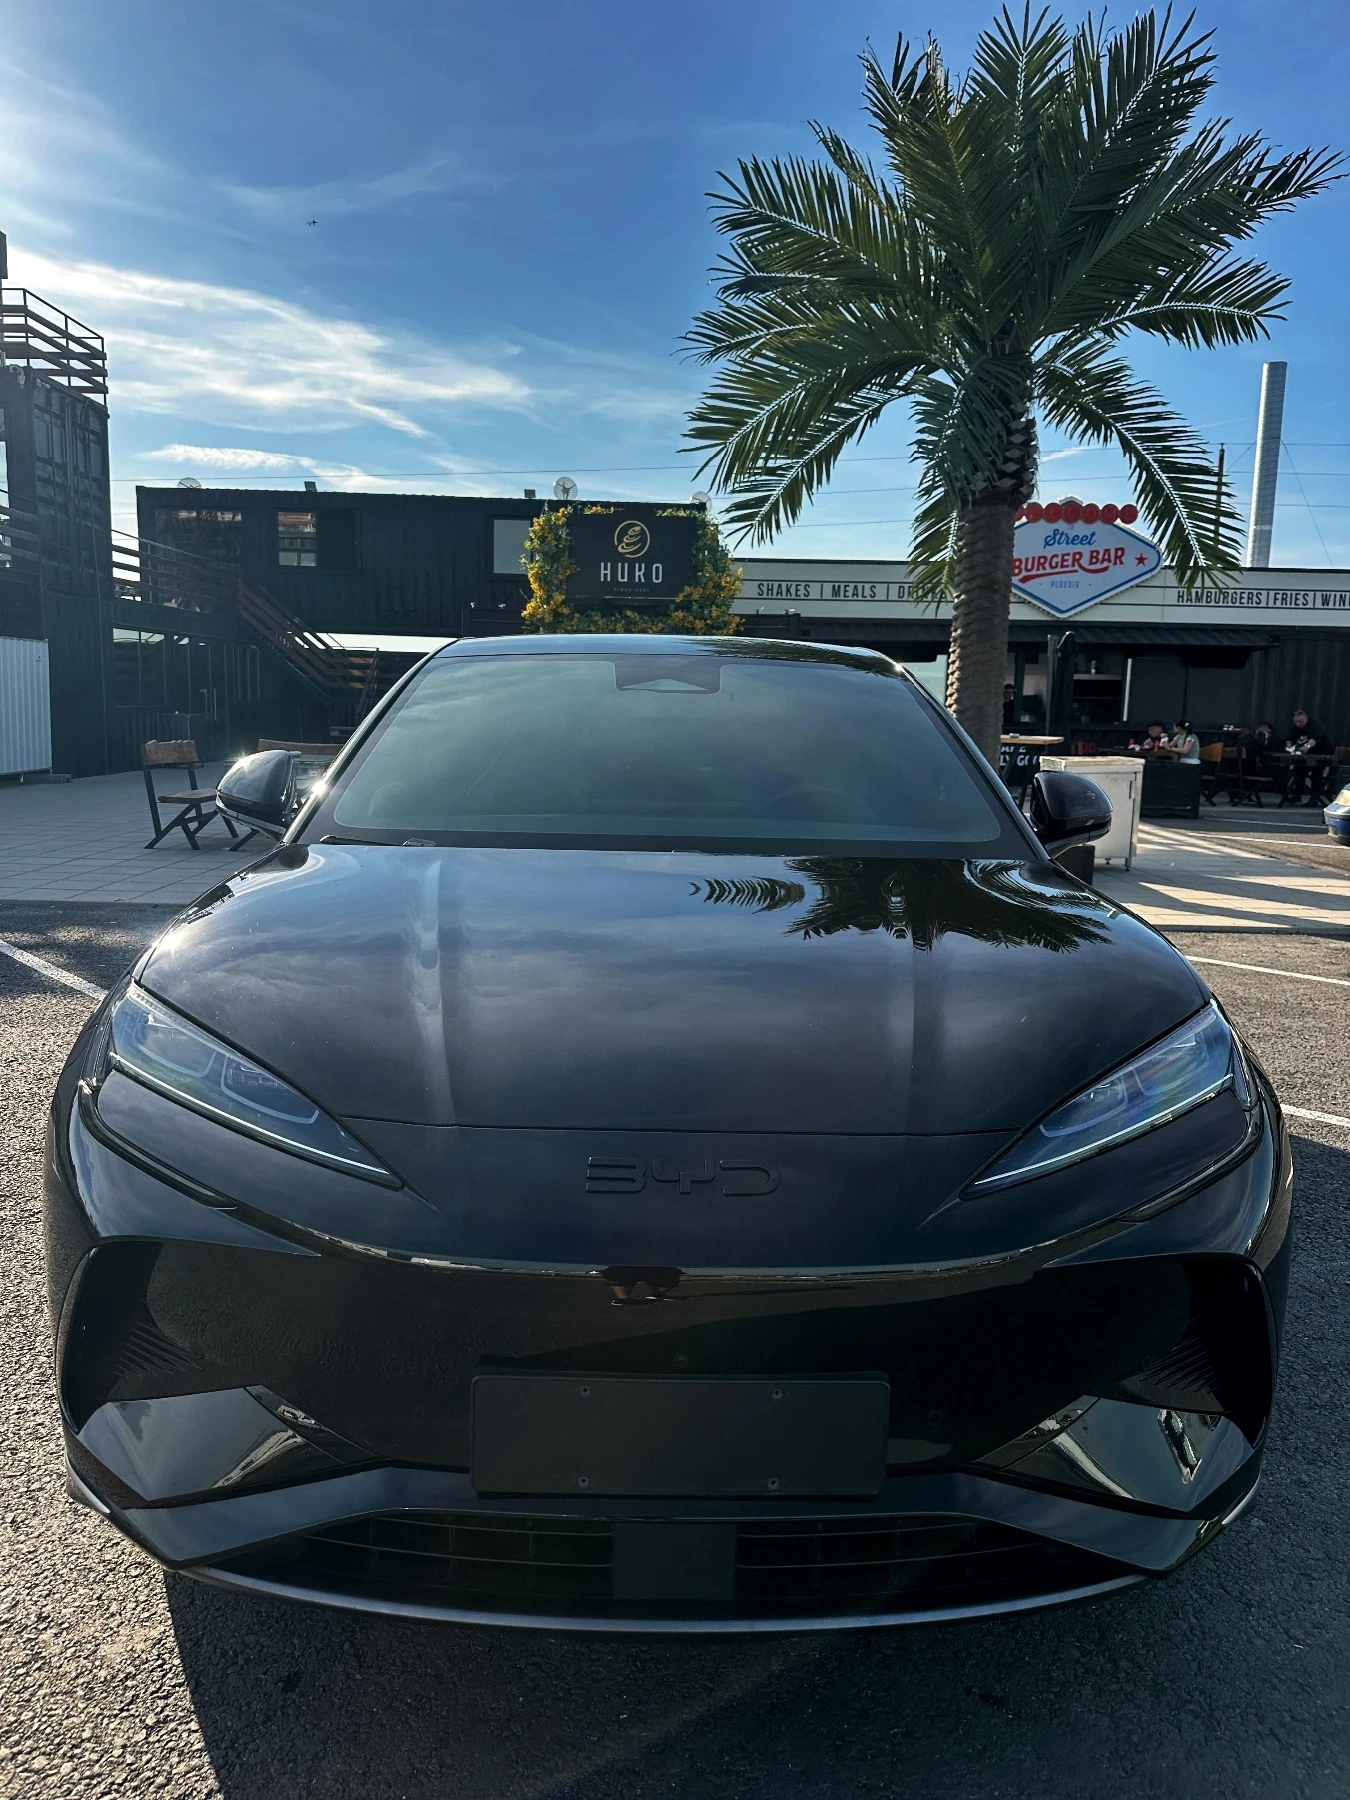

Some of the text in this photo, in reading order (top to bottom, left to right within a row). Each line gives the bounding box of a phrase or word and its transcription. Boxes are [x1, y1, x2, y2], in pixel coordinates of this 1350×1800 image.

[1043, 528, 1097, 549] Street
[1012, 547, 1126, 577] BURGER BAR
[600, 562, 663, 584] HUKO
[757, 582, 811, 597] SHAKES
[831, 584, 877, 599] MEALS
[1273, 592, 1309, 606] FRIES
[1321, 593, 1350, 607] WIN
[586, 1157, 781, 1197] BYD
